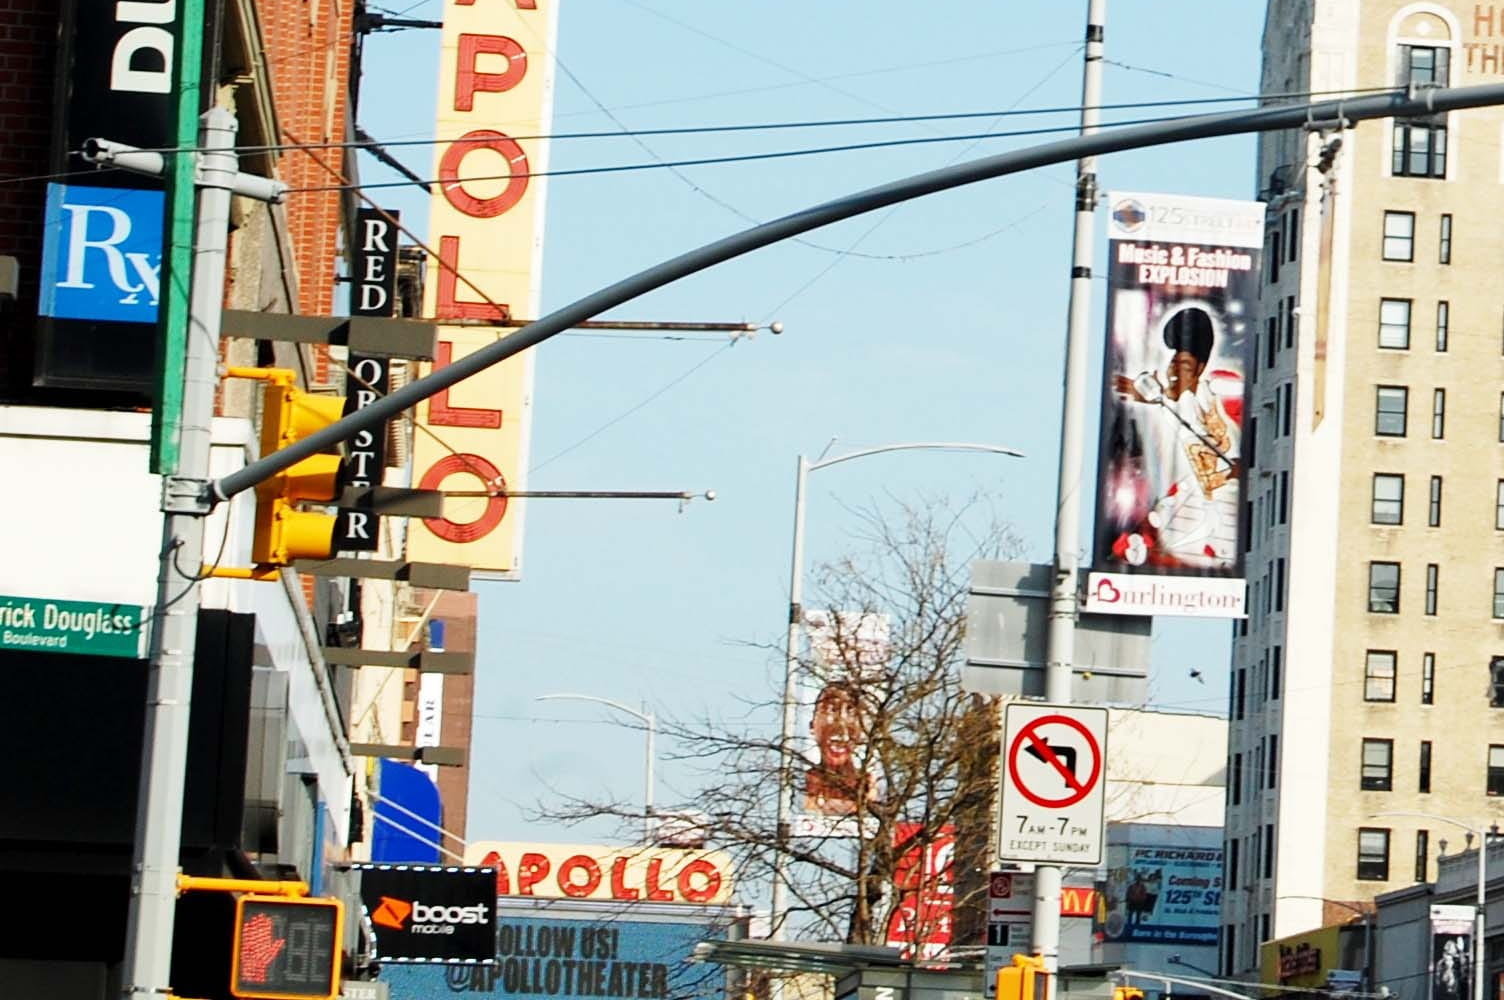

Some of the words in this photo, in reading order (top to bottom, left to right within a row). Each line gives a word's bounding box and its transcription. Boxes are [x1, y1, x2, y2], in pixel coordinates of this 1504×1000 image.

[359, 218, 389, 311] RED
[1118, 243, 1168, 265] Music
[1171, 246, 1185, 266] &
[1188, 247, 1252, 271] Fashion
[1139, 264, 1229, 288] EXPLOSION
[1097, 578, 1238, 612] Burlington
[43, 603, 133, 640] Douglass
[3, 630, 68, 648] Boulevard
[1010, 839, 1047, 851] EXCEPT
[1053, 841, 1091, 853] SUNDAY
[480, 850, 723, 902] APOLLO
[412, 901, 489, 925] boost
[411, 924, 455, 935] mobile
[500, 925, 579, 958] OLLOW
[581, 928, 619, 960] US!
[446, 958, 669, 999] @APOLLOTHEATER
